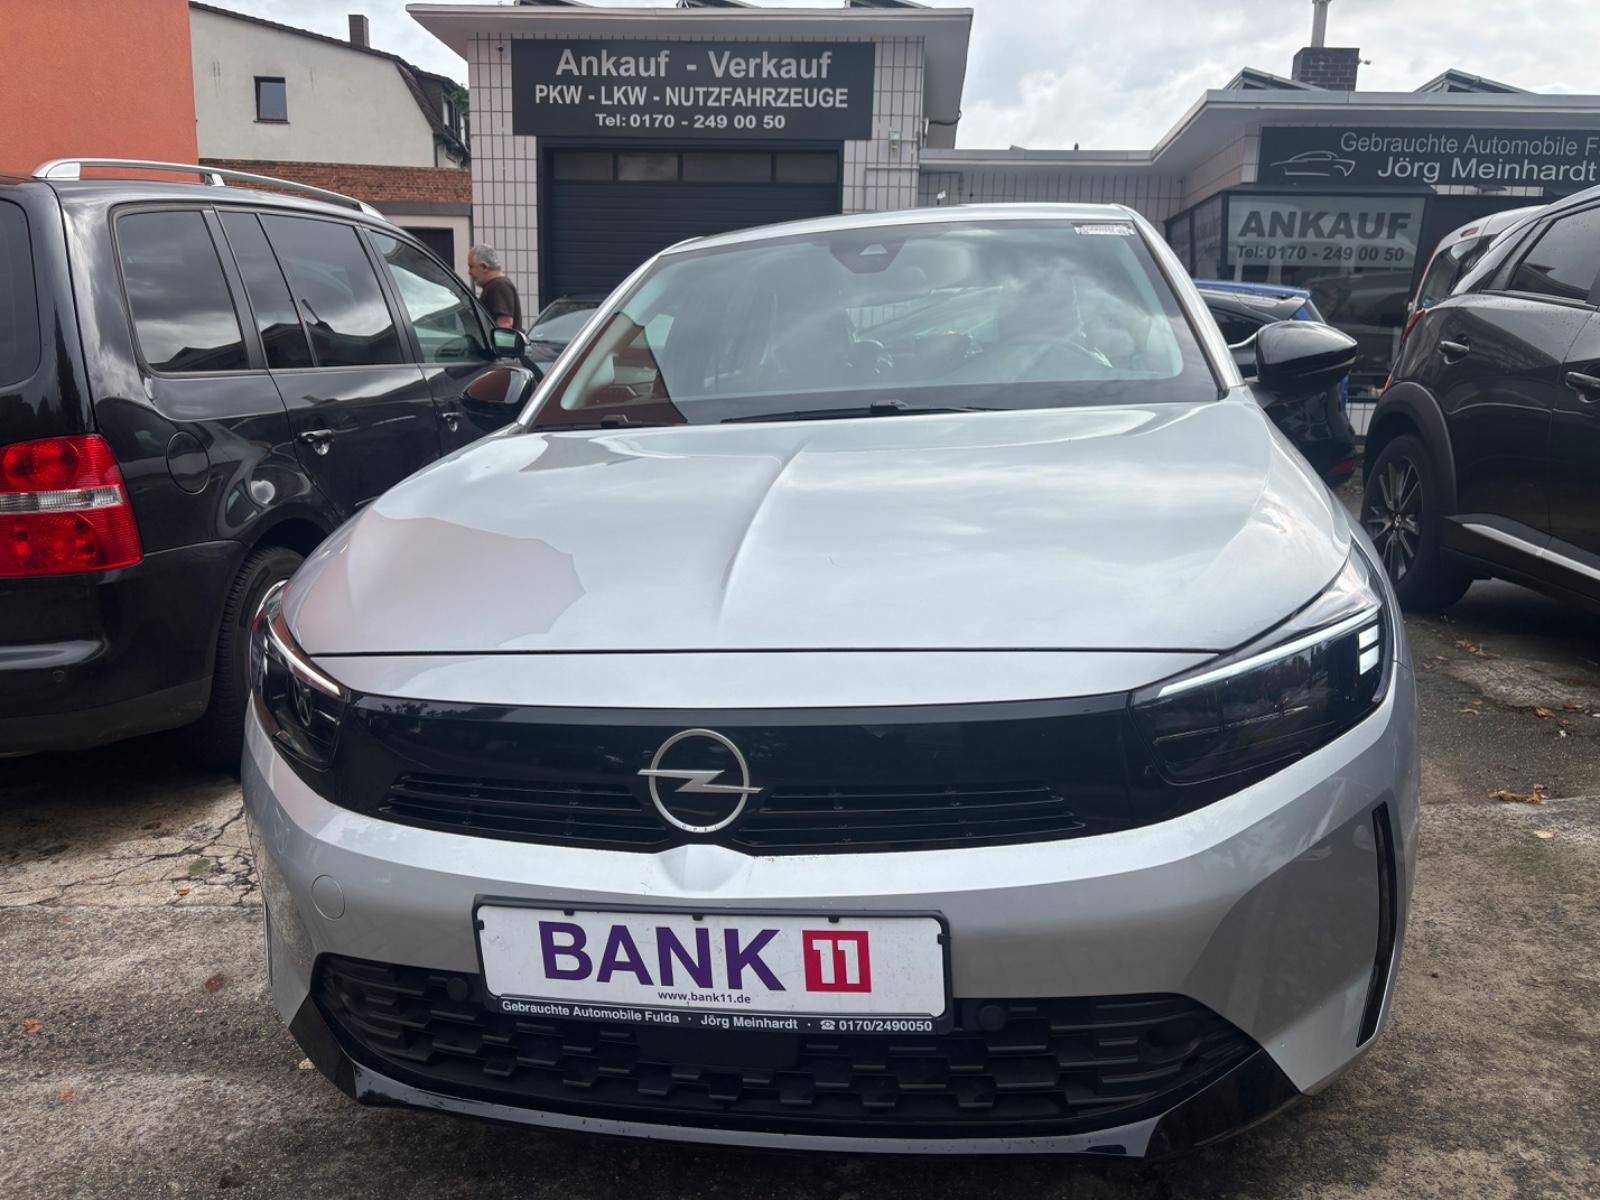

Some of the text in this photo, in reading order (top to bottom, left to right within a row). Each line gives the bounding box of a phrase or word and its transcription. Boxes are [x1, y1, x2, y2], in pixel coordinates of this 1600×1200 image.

[556, 49, 670, 77] Ankauf
[707, 51, 833, 79] Verkauf
[535, 85, 582, 104] PKW
[601, 86, 647, 105] LKW
[665, 88, 848, 108] NUTZFAHRZEUGE
[595, 114, 626, 127] Tel:
[630, 114, 675, 128] 0170
[694, 115, 728, 129] 249
[733, 115, 757, 129] 00
[763, 115, 786, 129] 50
[1340, 132, 1458, 153] Gebrauchte
[1463, 134, 1578, 156] Automobile
[1377, 155, 1597, 182] Jörg Meinhardt
[1238, 210, 1412, 240] ANKAUF
[1266, 246, 1306, 260] 0170
[1322, 246, 1353, 261] 249
[1358, 246, 1379, 261] 00
[1384, 246, 1405, 262] 50
[539, 921, 861, 991] BANK 11
[658, 991, 752, 1004] www.bank11.de
[502, 1000, 933, 1032] Gebrauchte Automobile Fulda Jörg Meinhardt 0170/2490050
